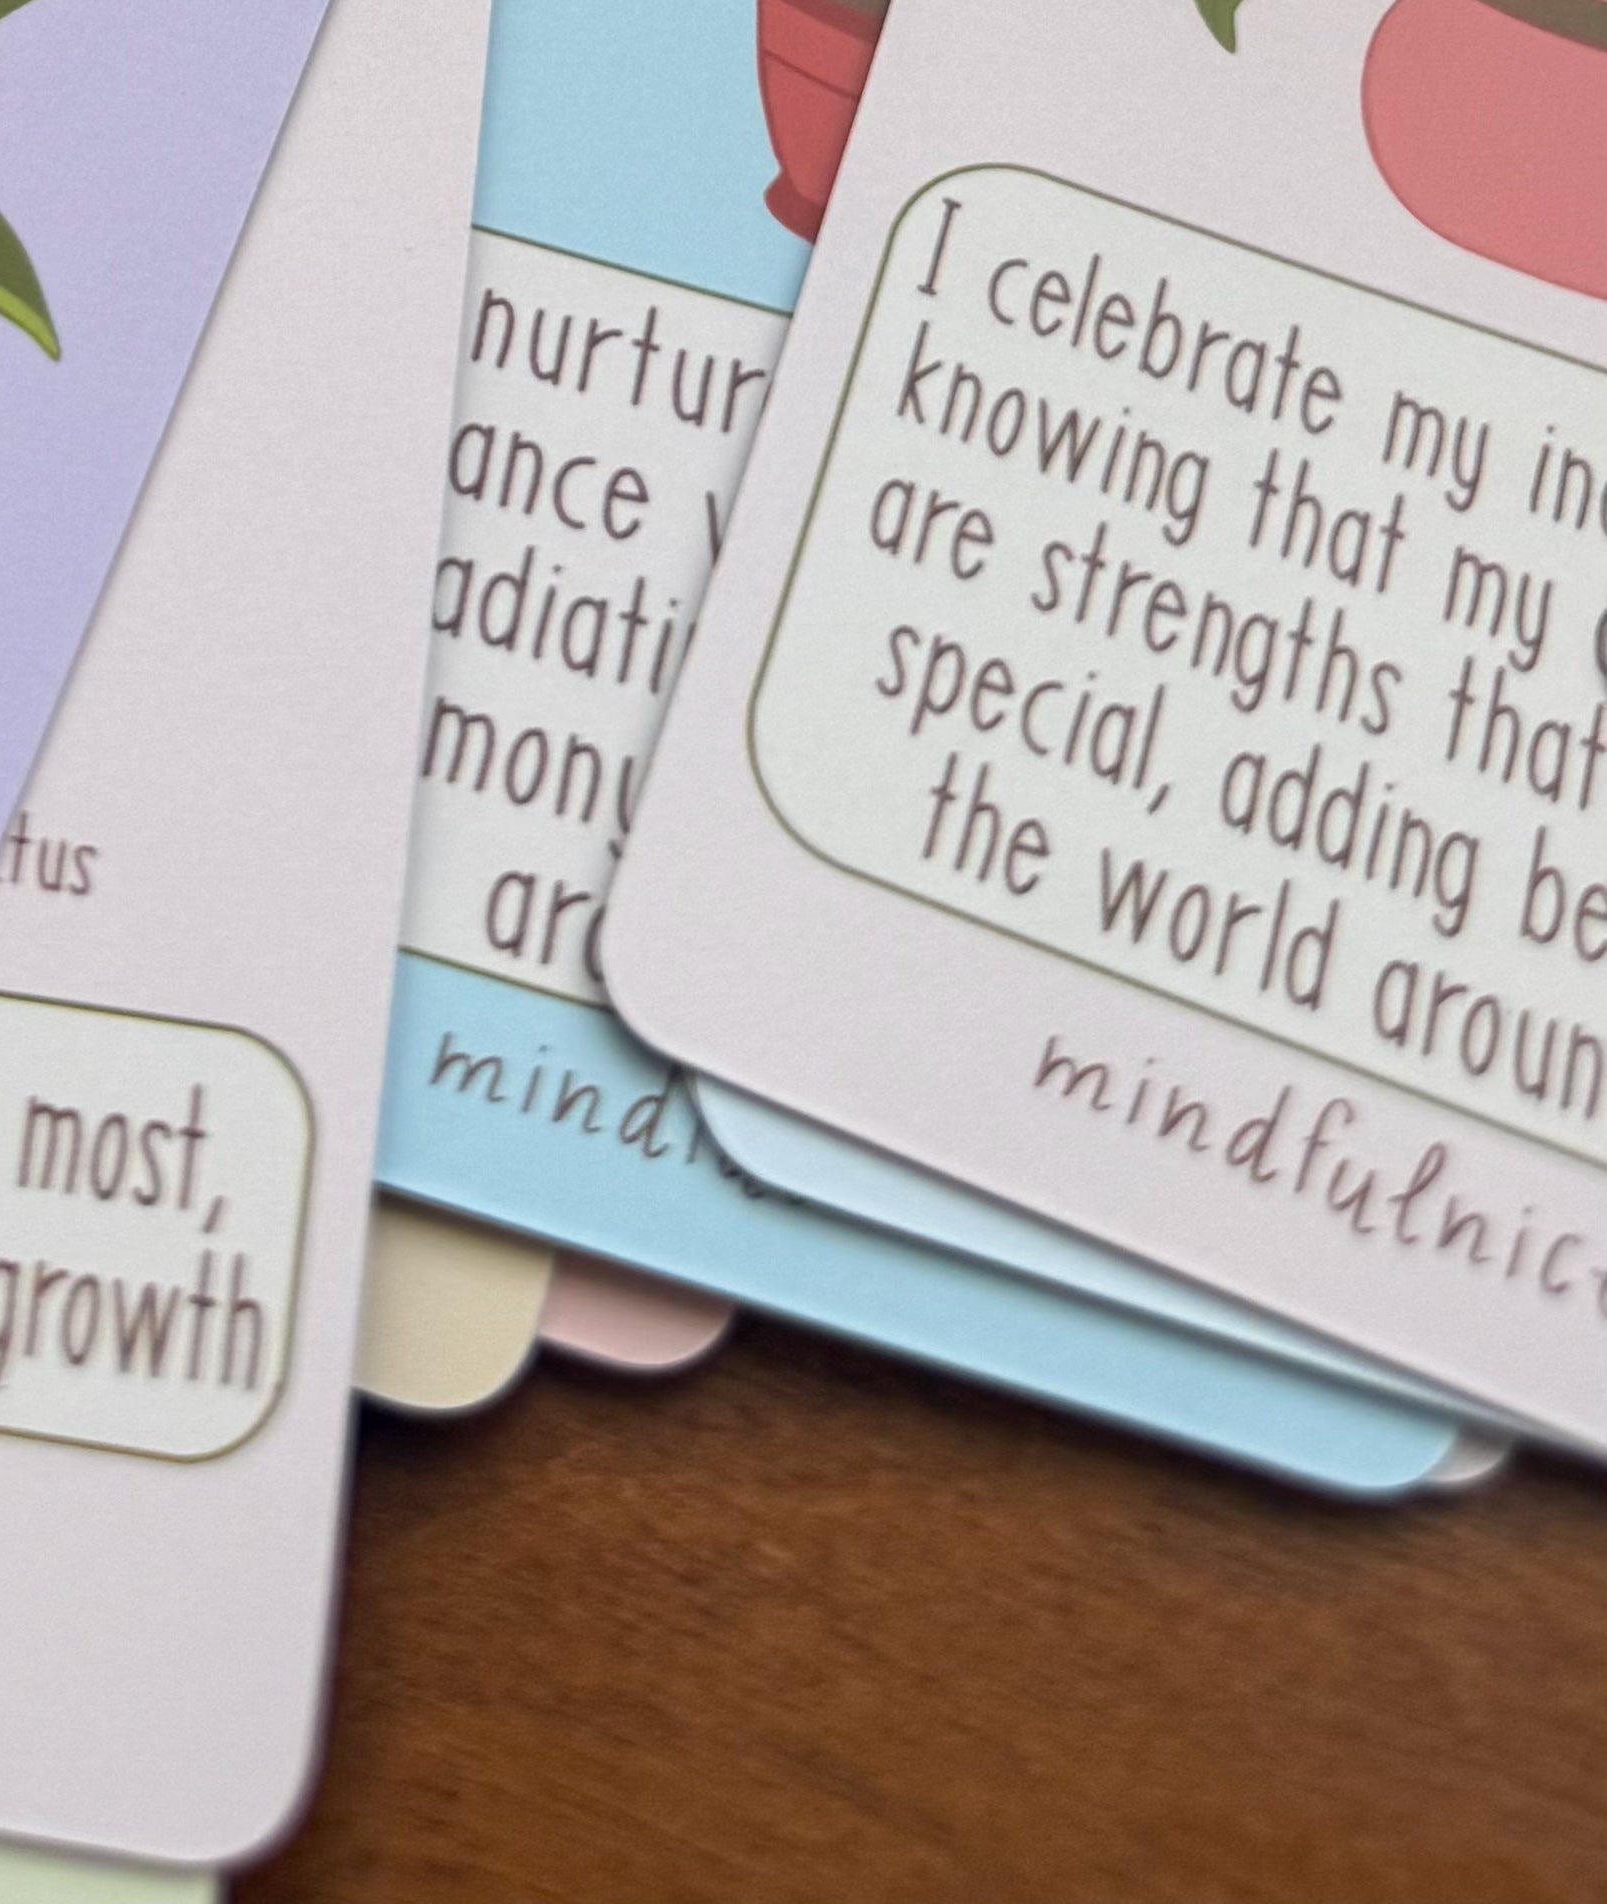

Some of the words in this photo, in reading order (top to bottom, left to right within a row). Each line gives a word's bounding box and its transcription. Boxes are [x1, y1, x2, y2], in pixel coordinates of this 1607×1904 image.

[471, 286, 773, 436] nurtur
[896, 322, 1209, 546] knowing
[1250, 447, 1406, 594] that
[1444, 545, 1553, 673] my
[917, 197, 963, 299] I
[989, 252, 1344, 437] celebrate
[1383, 391, 1489, 513] my
[1530, 425, 1607, 538] in
[432, 546, 697, 697] adiati
[869, 475, 996, 580] are
[1031, 520, 1403, 737] strengths
[1446, 655, 1607, 811] that
[876, 621, 1175, 814] special,
[1219, 746, 1480, 939] adding
[919, 751, 1052, 897] the
[1097, 843, 1342, 1013] world
[17, 1082, 230, 1236] most,
